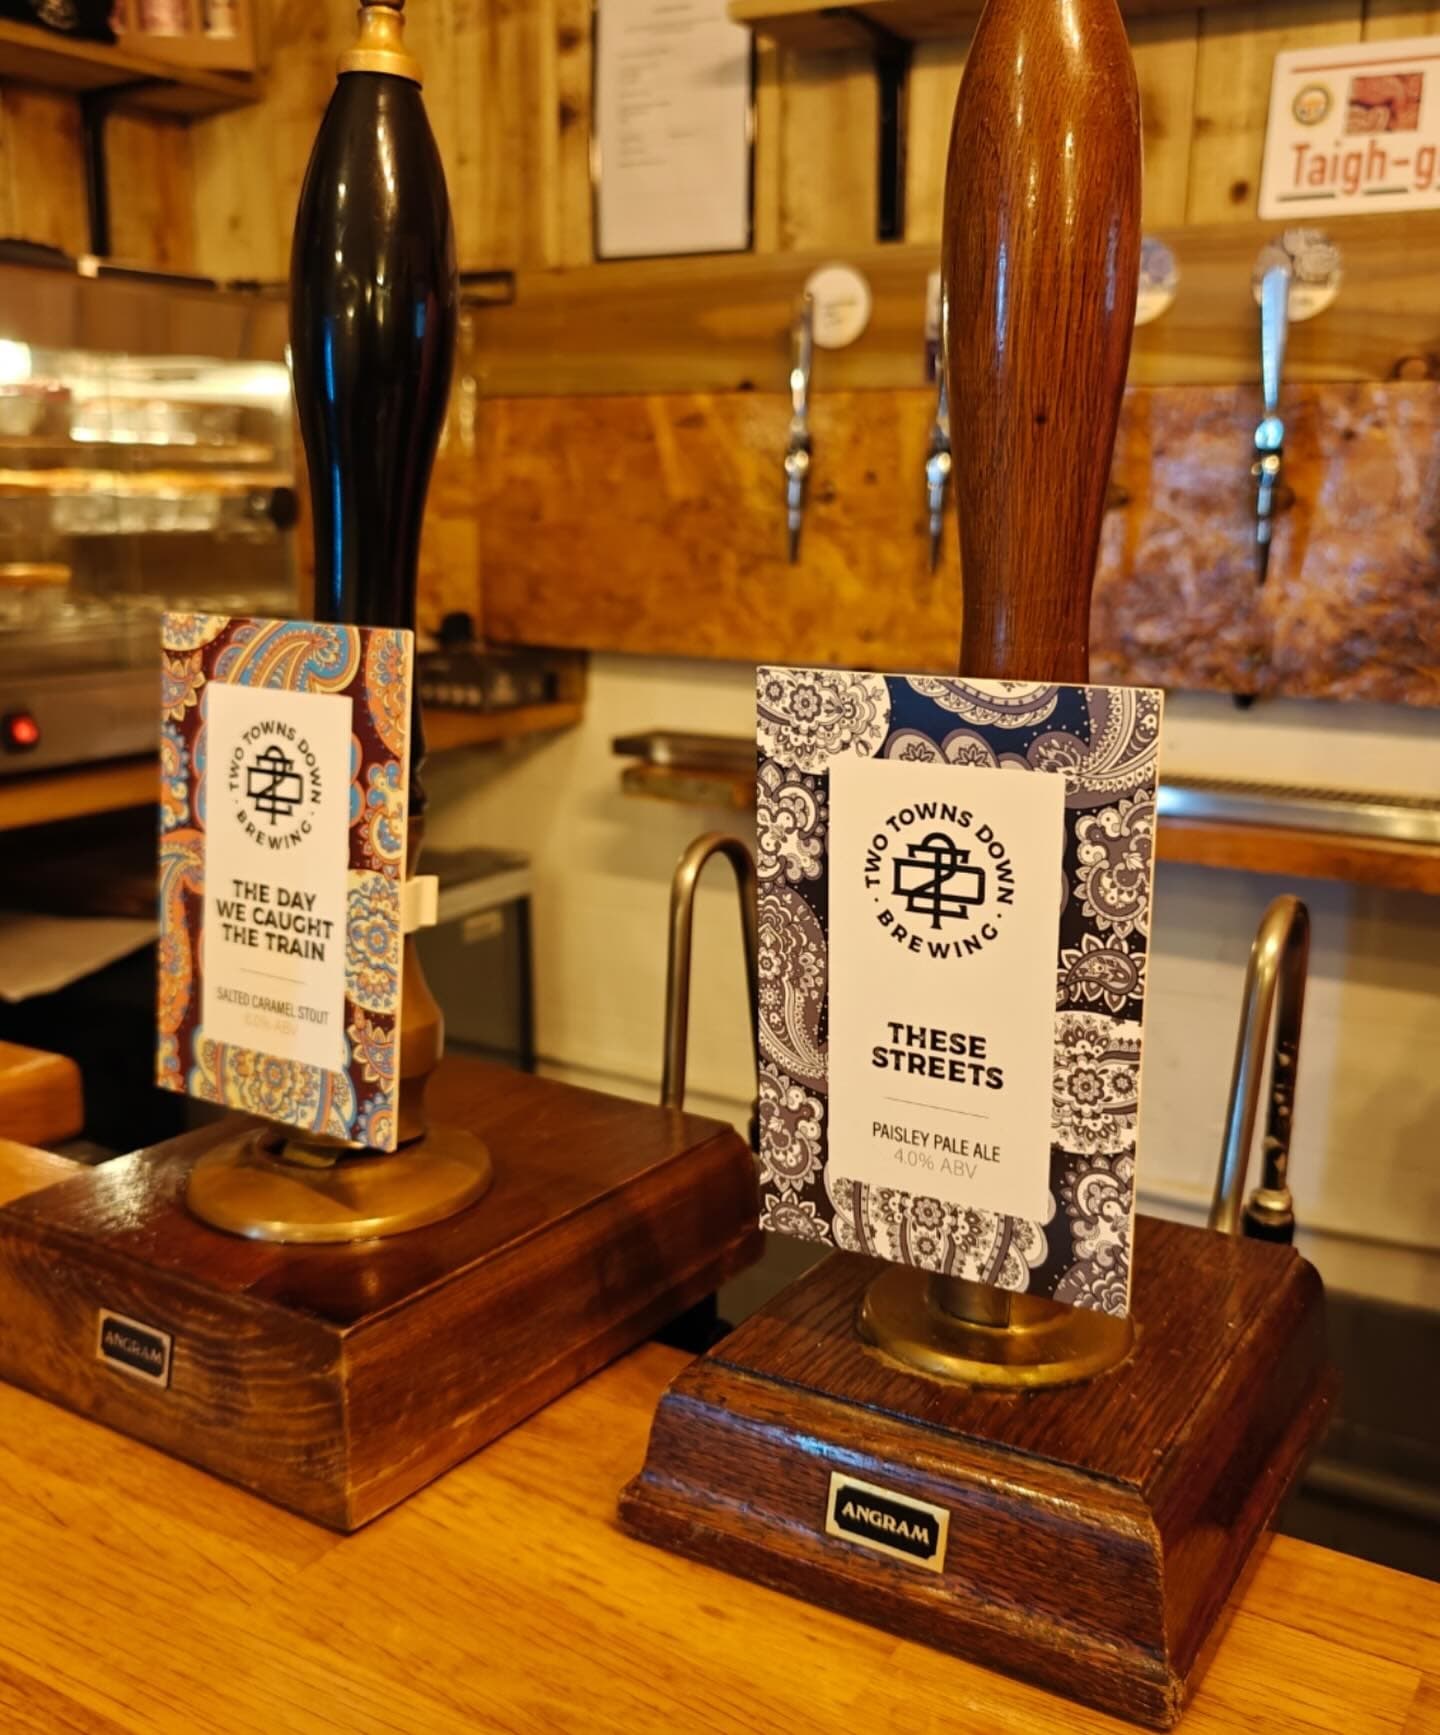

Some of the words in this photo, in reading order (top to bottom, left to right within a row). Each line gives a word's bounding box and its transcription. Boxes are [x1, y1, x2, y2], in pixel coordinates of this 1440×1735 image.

[1293, 139, 1440, 195] Taigh-g
[229, 747, 244, 791] TWO
[242, 720, 297, 745] TOWNS
[297, 739, 322, 804] DOWN
[236, 809, 312, 850] BREWING
[865, 834, 888, 888] TWO
[886, 802, 973, 832] TOWNS
[975, 824, 1014, 905] DOWN
[233, 880, 270, 904] THE
[277, 888, 317, 912] DAY
[216, 899, 246, 922] WE
[252, 907, 333, 939] CAUGHT
[877, 908, 998, 959] BREWING
[222, 923, 259, 947] THE
[265, 932, 325, 962] TRAIN
[216, 986, 250, 1006] SALTED
[252, 994, 296, 1018] CARAMEL
[298, 1005, 328, 1025] STOUT
[887, 1021, 987, 1060] THESE
[872, 1046, 1004, 1090] STREETS
[872, 1121, 930, 1147] PAISLEY
[934, 1133, 969, 1157] PALE
[973, 1142, 1000, 1163] ALE
[894, 1147, 934, 1171] 4.0%
[940, 1157, 978, 1179] ABV
[104, 1330, 162, 1365] ANGRAM
[841, 1501, 930, 1545] ANGRAM
